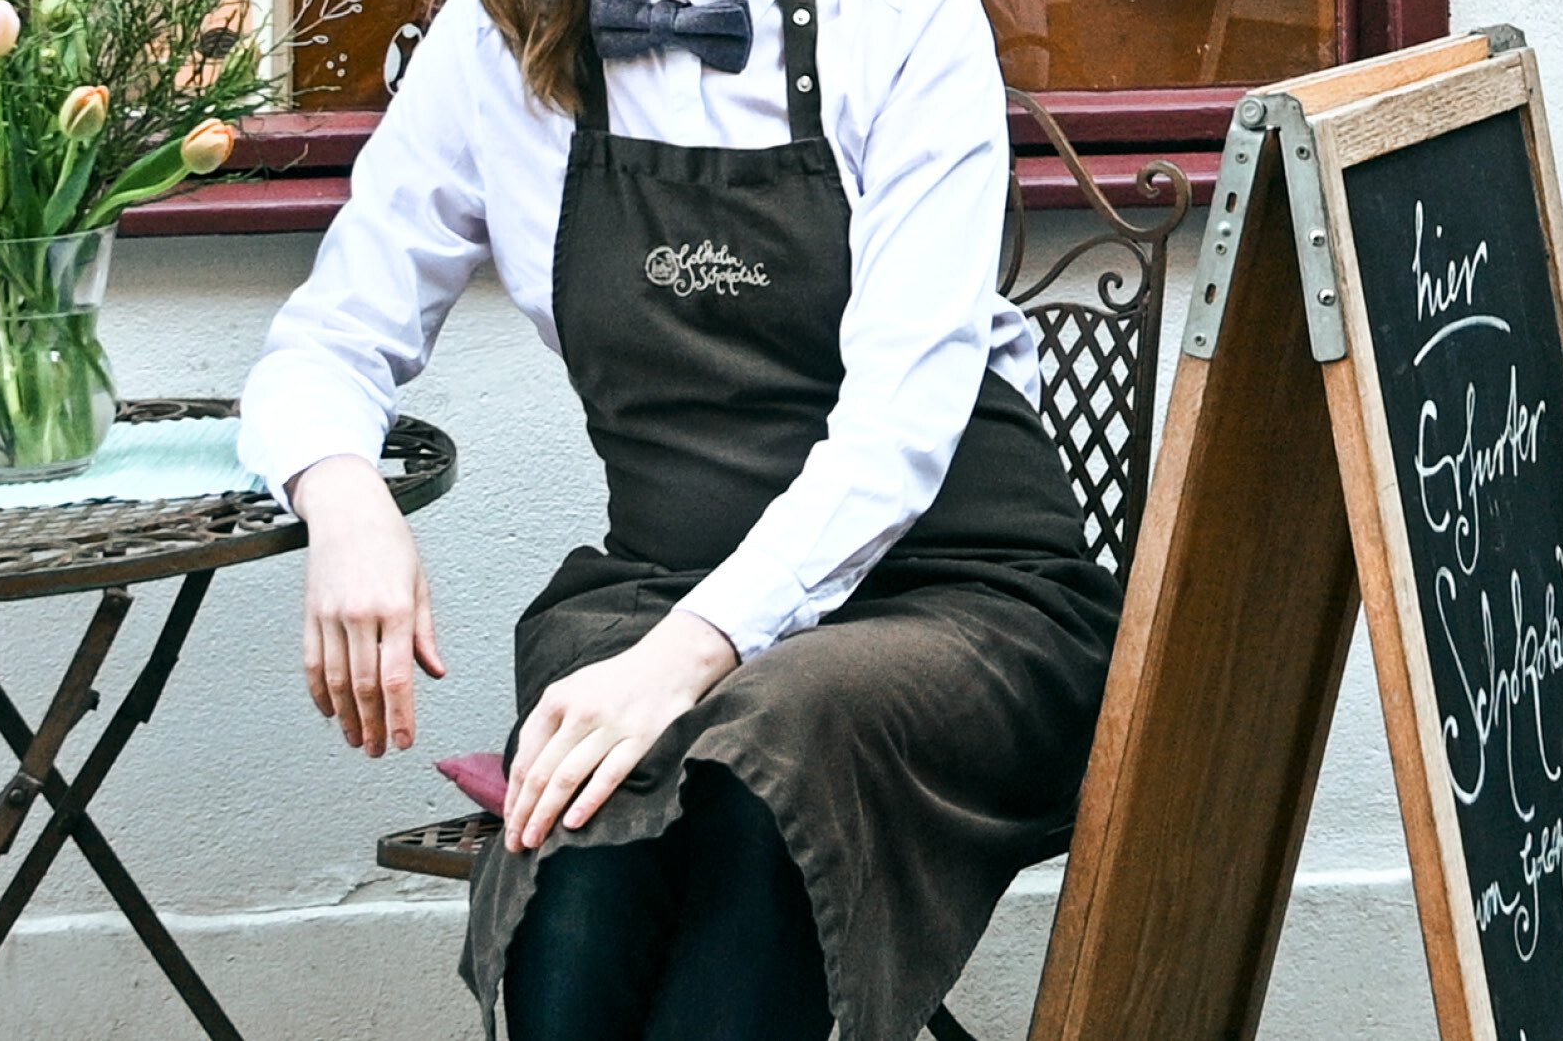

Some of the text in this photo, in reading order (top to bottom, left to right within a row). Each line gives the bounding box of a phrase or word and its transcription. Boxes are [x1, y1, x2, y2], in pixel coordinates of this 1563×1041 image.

[673, 240, 743, 297] Goldhelm
[1412, 199, 1488, 322] hier
[1414, 365, 1546, 575] Erfurter
